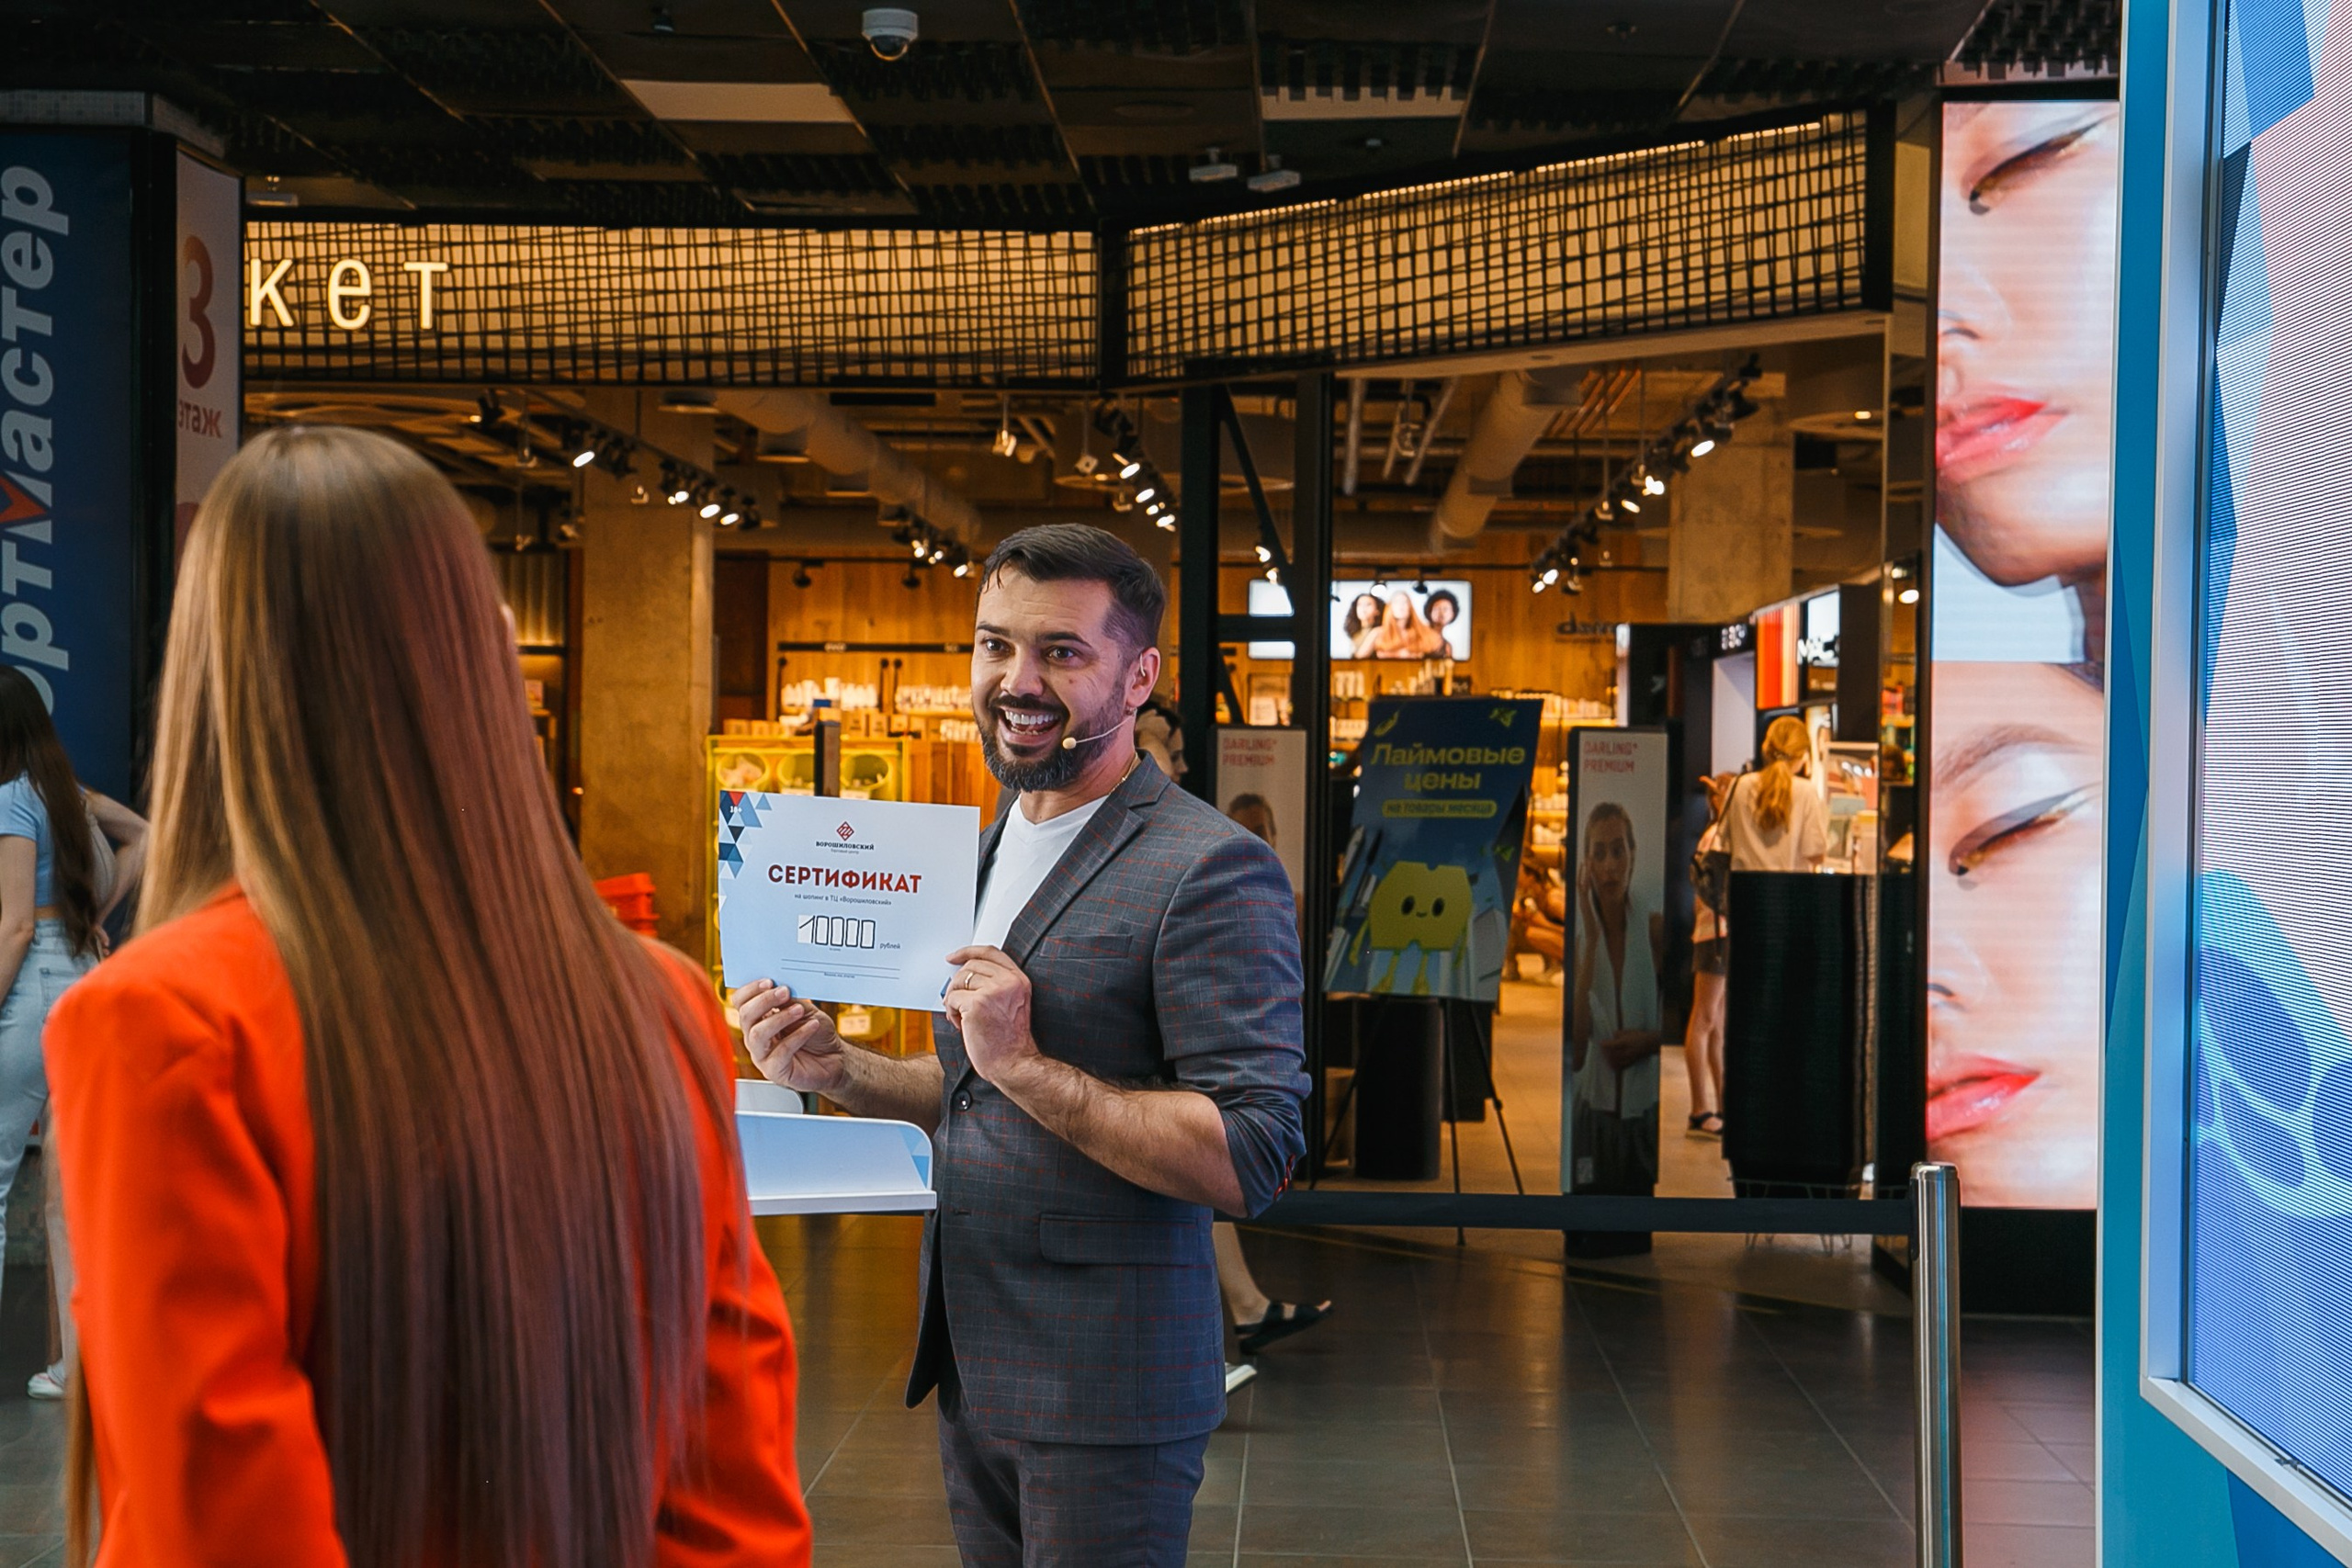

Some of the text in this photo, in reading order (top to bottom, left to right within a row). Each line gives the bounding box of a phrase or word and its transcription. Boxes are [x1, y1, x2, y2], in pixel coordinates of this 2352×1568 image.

[183, 235, 216, 389] 3
[178, 400, 222, 439] этаж
[1371, 743, 1526, 765] Лаймовые
[1404, 773, 1481, 793] цены
[815, 840, 875, 851] ВОРОШИЛОВСКИЙ
[768, 864, 922, 893] СЕРТИФИКАТ
[840, 896, 892, 906] «Ворошиловский»
[798, 915, 876, 949] 10000
[879, 942, 901, 950] рублей
